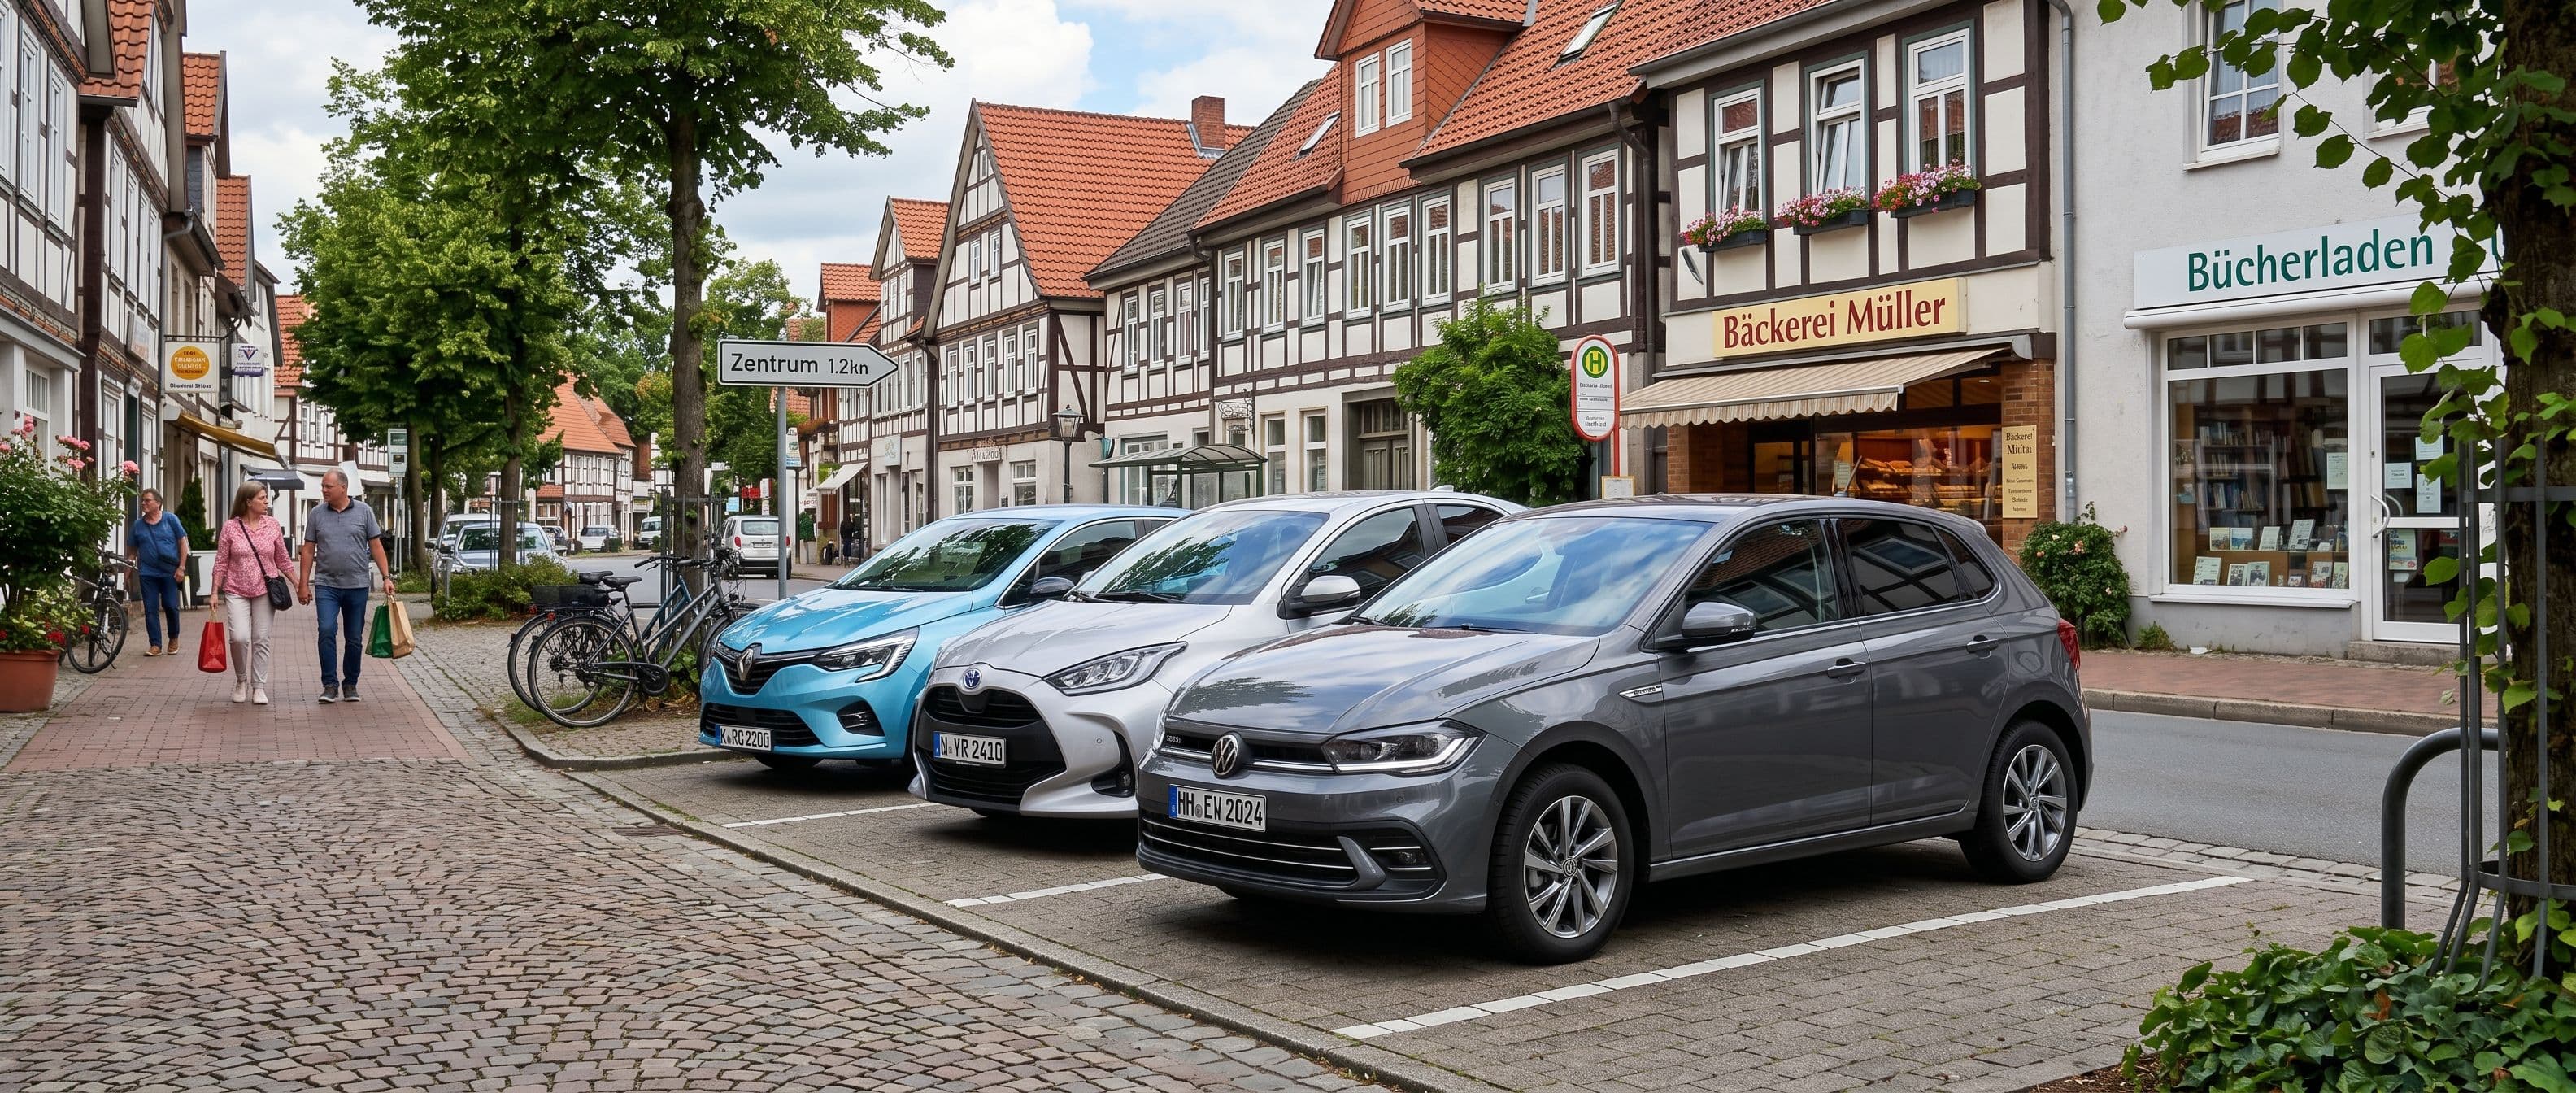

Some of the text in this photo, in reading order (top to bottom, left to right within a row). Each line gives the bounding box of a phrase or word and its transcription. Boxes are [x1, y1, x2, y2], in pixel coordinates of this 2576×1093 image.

[2188, 229, 2433, 292] Bücherladen
[1723, 290, 1946, 349] Bäckerei Müller
[730, 353, 818, 373] Zentrum
[720, 728, 727, 744] K
[954, 737, 969, 758] YR
[1177, 790, 1194, 816] HH
[1225, 798, 1263, 826] 2024
